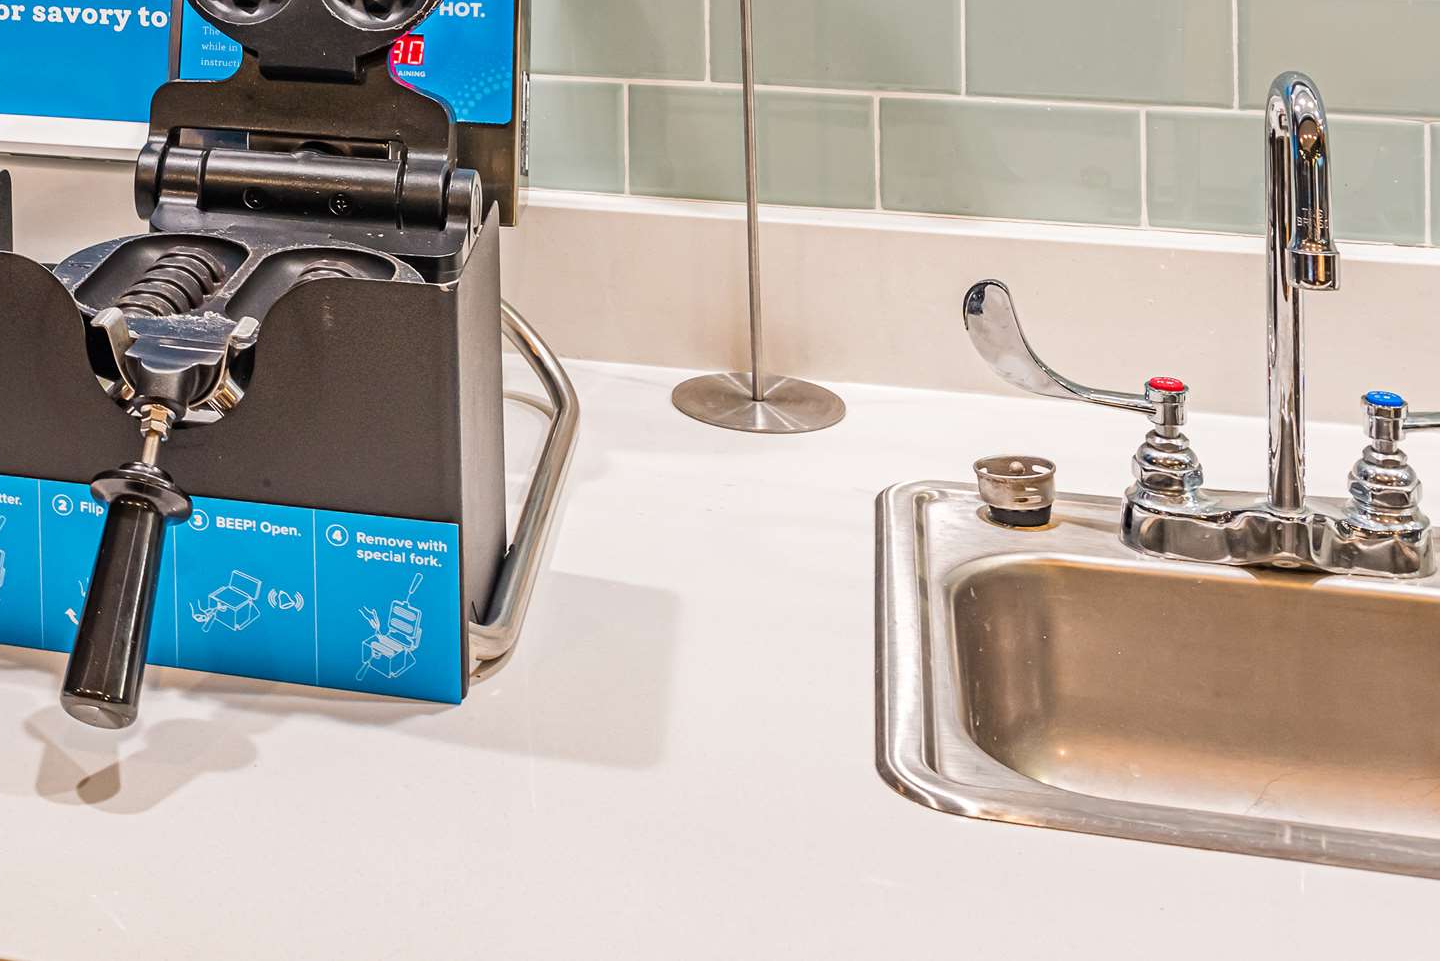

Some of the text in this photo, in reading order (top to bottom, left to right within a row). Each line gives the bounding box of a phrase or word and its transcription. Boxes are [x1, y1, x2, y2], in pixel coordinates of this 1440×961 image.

[32, 4, 132, 32] savory
[138, 6, 170, 28] to
[439, 1, 486, 18] HOT.
[201, 41, 238, 52] while in
[80, 501, 104, 517] Flip
[215, 516, 257, 532] BEEP!
[260, 522, 302, 537] Open.
[356, 532, 413, 549] Remove
[416, 539, 448, 553] with
[356, 547, 443, 568] special fork.
